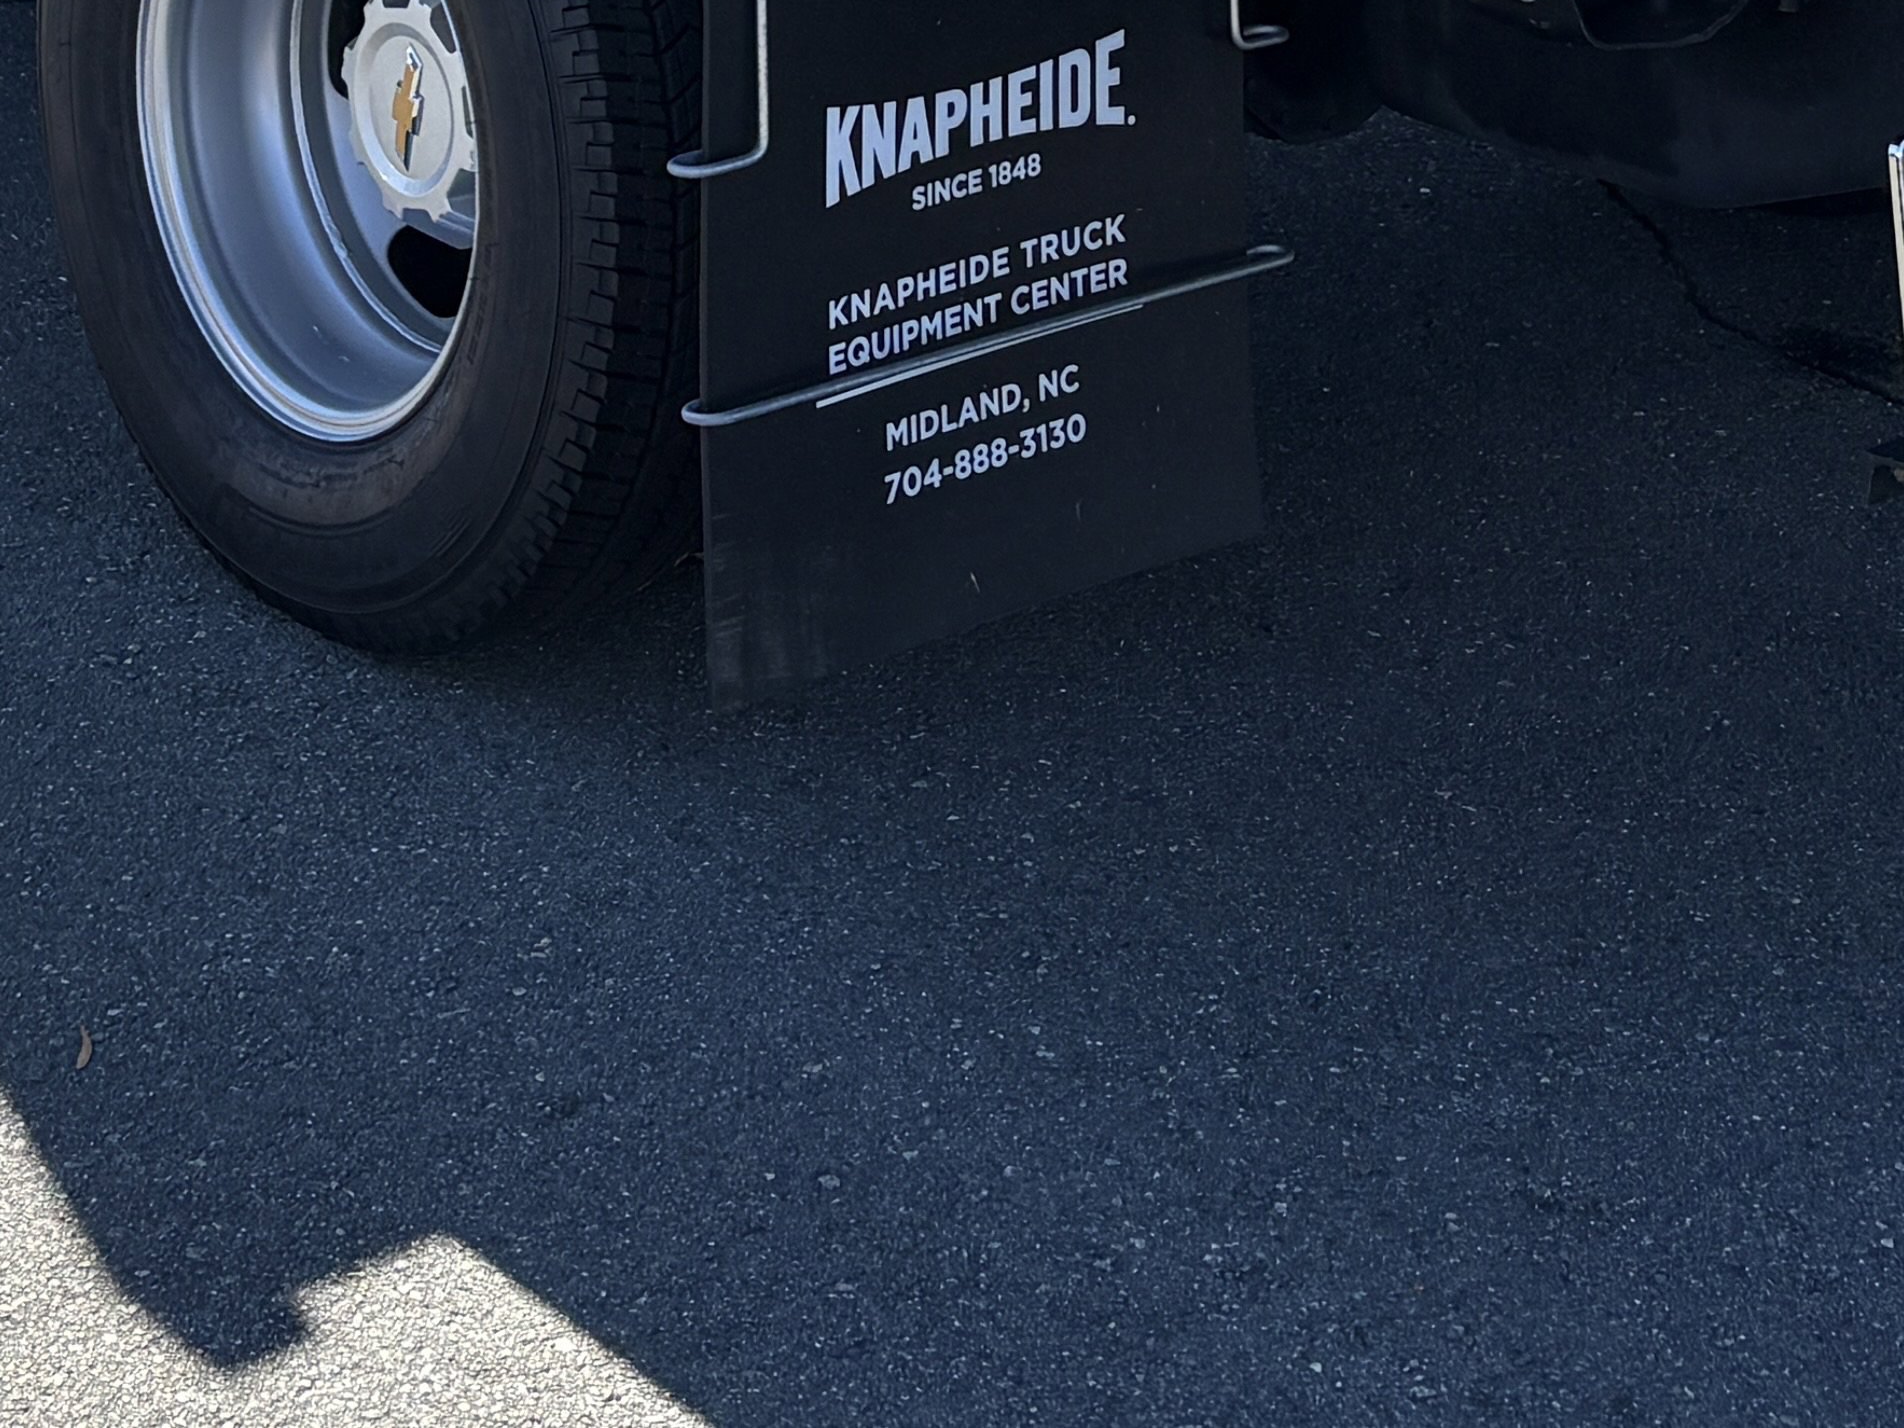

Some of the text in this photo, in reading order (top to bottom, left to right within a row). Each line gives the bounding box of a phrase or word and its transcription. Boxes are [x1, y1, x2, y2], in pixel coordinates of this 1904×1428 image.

[911, 153, 1042, 211] SINCE 1848
[827, 213, 1127, 331] KNAPHEIDE TRUCK
[827, 258, 1129, 376] EQUIPMENT CENTER
[885, 363, 1081, 452] MIDLAND, NC
[883, 413, 1087, 505] 704-888-3130
